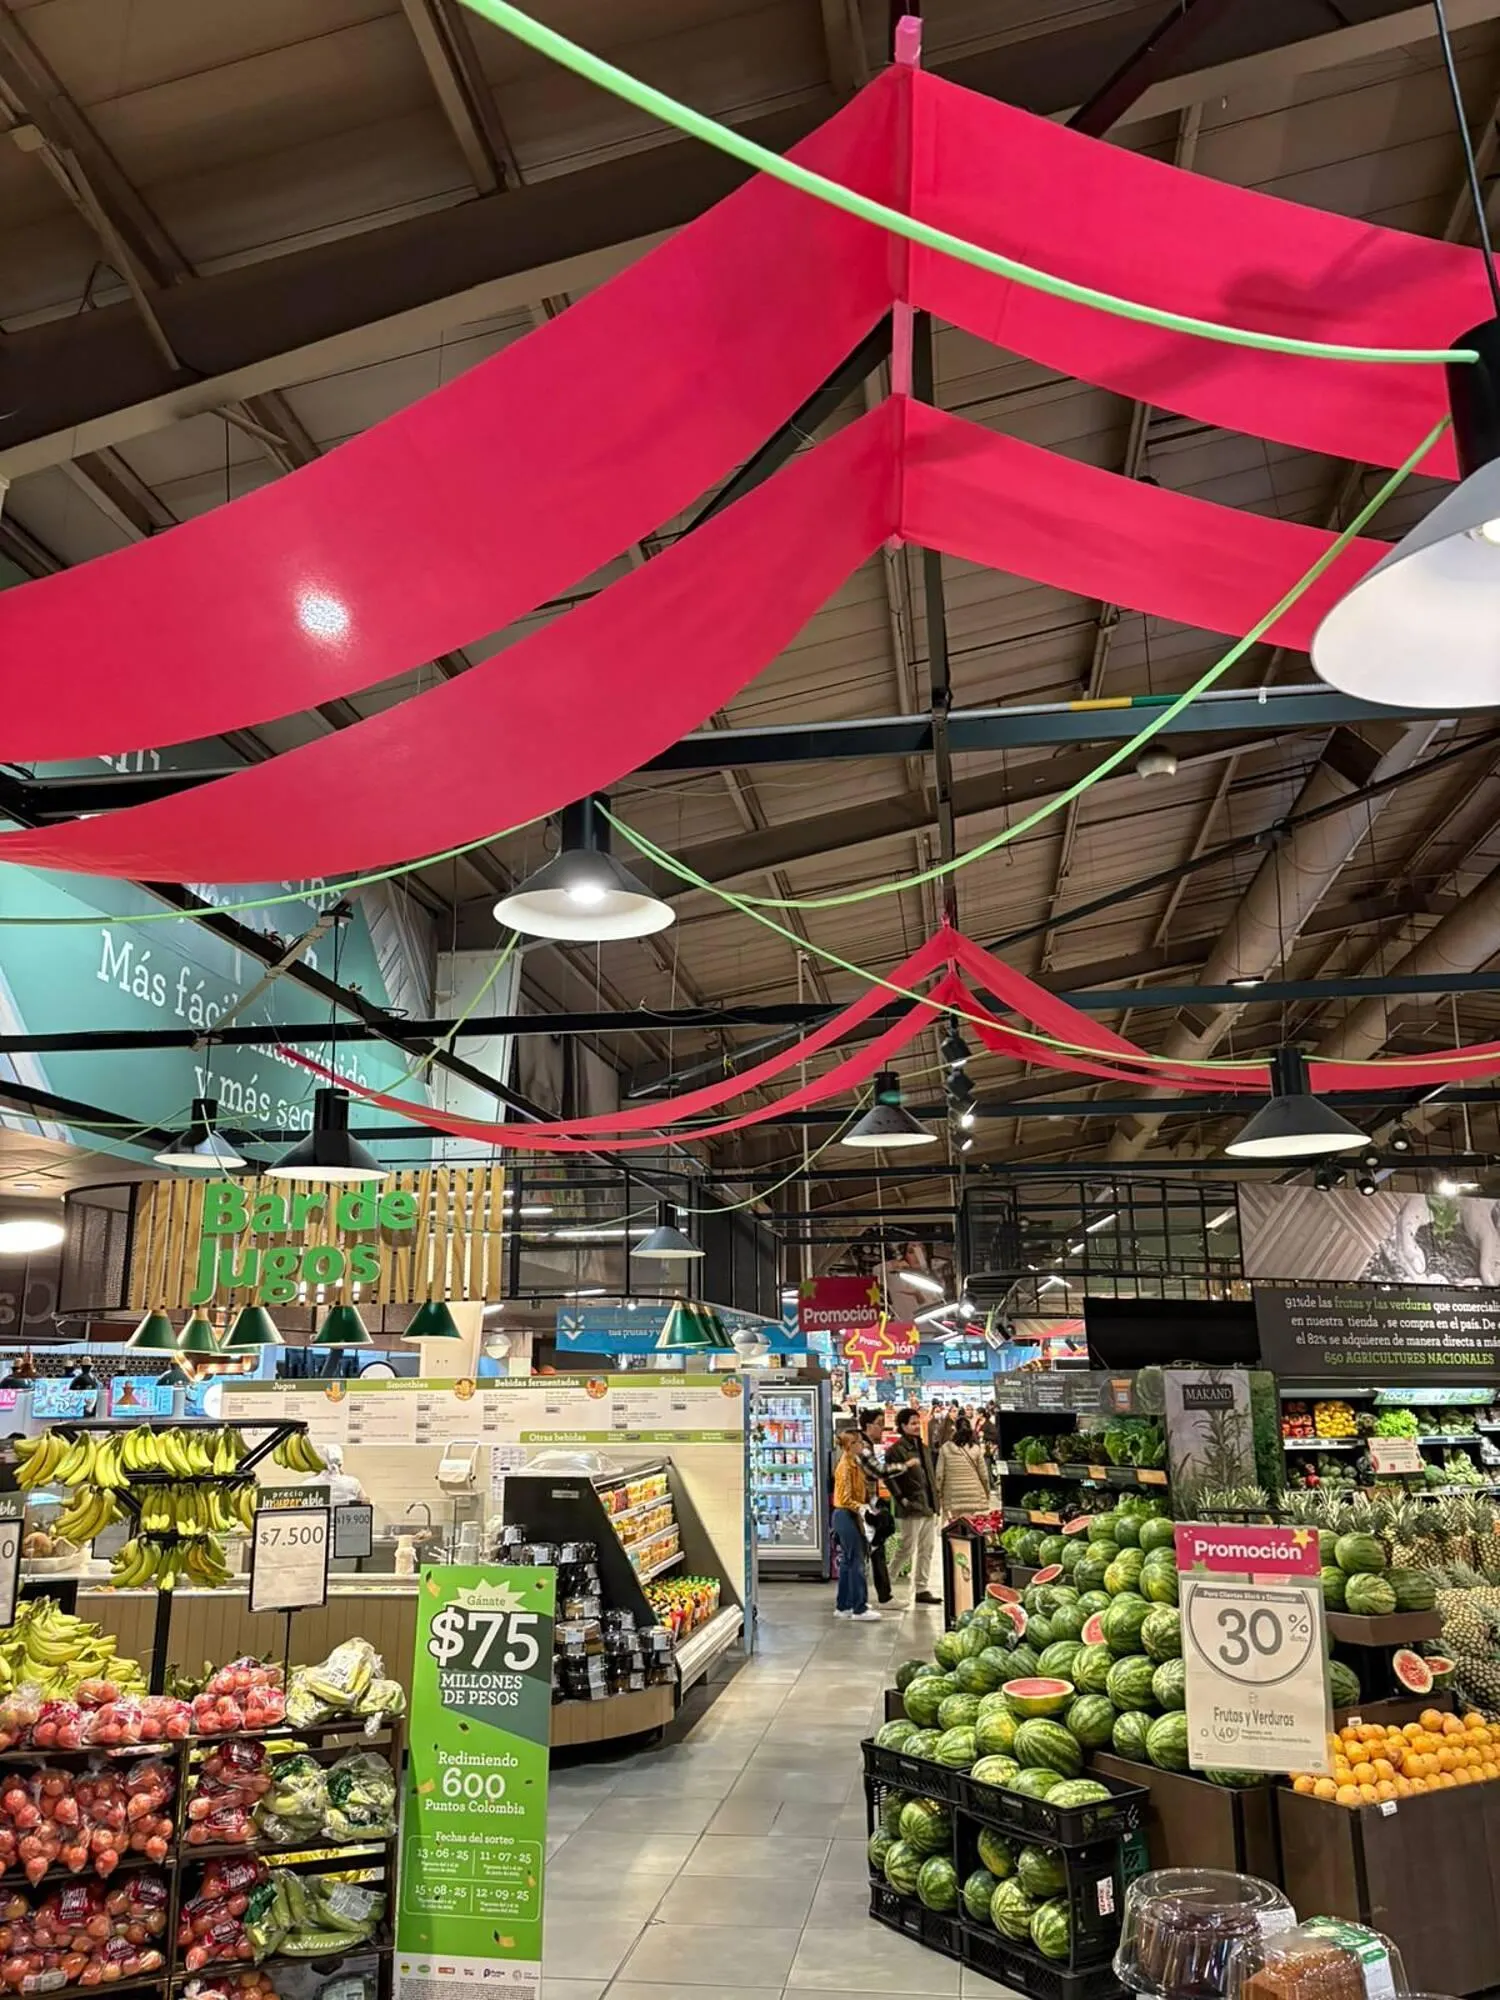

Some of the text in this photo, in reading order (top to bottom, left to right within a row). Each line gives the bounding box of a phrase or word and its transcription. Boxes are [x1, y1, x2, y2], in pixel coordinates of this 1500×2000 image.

[97, 928, 167, 1007] Más
[217, 1073, 271, 1122] más
[203, 1179, 419, 1234] Bar de
[189, 1236, 382, 1306] Jugos
[1317, 1295, 1333, 1308] las
[1334, 1295, 1364, 1309] frutas
[1365, 1300, 1373, 1312] y
[1373, 1296, 1389, 1310] las
[1390, 1297, 1432, 1311] verduras
[1433, 1302, 1451, 1314] que
[803, 1304, 878, 1325] Promoción
[1291, 1317, 1305, 1327] en
[1305, 1317, 1344, 1327] nuestra
[1347, 1314, 1379, 1328] tienda
[1387, 1318, 1398, 1328] se
[1400, 1319, 1436, 1332] compra
[1436, 1320, 1449, 1329] en
[1449, 1316, 1459, 1329] el
[1482, 1318, 1496, 1330] De
[1295, 1331, 1306, 1345] el
[1306, 1332, 1328, 1345] 82%
[1329, 1335, 1340, 1345] se
[1342, 1332, 1391, 1348] adquieren
[1391, 1333, 1405, 1346] de
[1405, 1337, 1441, 1346] manera
[1442, 1333, 1475, 1347] directa
[1475, 1339, 1483, 1347] a
[1324, 1351, 1495, 1365] 650 AGRICULTURES NACIONALES
[272, 1381, 297, 1391] Jugos
[494, 1378, 527, 1388] Bebidas
[529, 1432, 586, 1442] Otras bebidas
[273, 1490, 304, 1499] precio
[260, 1526, 324, 1547] $7.500
[1194, 1540, 1302, 1560] Promoción
[467, 1595, 506, 1606] Gánate
[428, 1607, 540, 1672] $75
[440, 1673, 523, 1690] MILLONES
[443, 1690, 519, 1706] DE PESOS
[1213, 1706, 1295, 1727] Frutas y Verduras
[438, 1751, 519, 1767] Redimiendo
[441, 1767, 506, 1801] 600
[424, 1799, 525, 1815] Puntos Colombia
[435, 1831, 515, 1845] Fechas del sorteo
